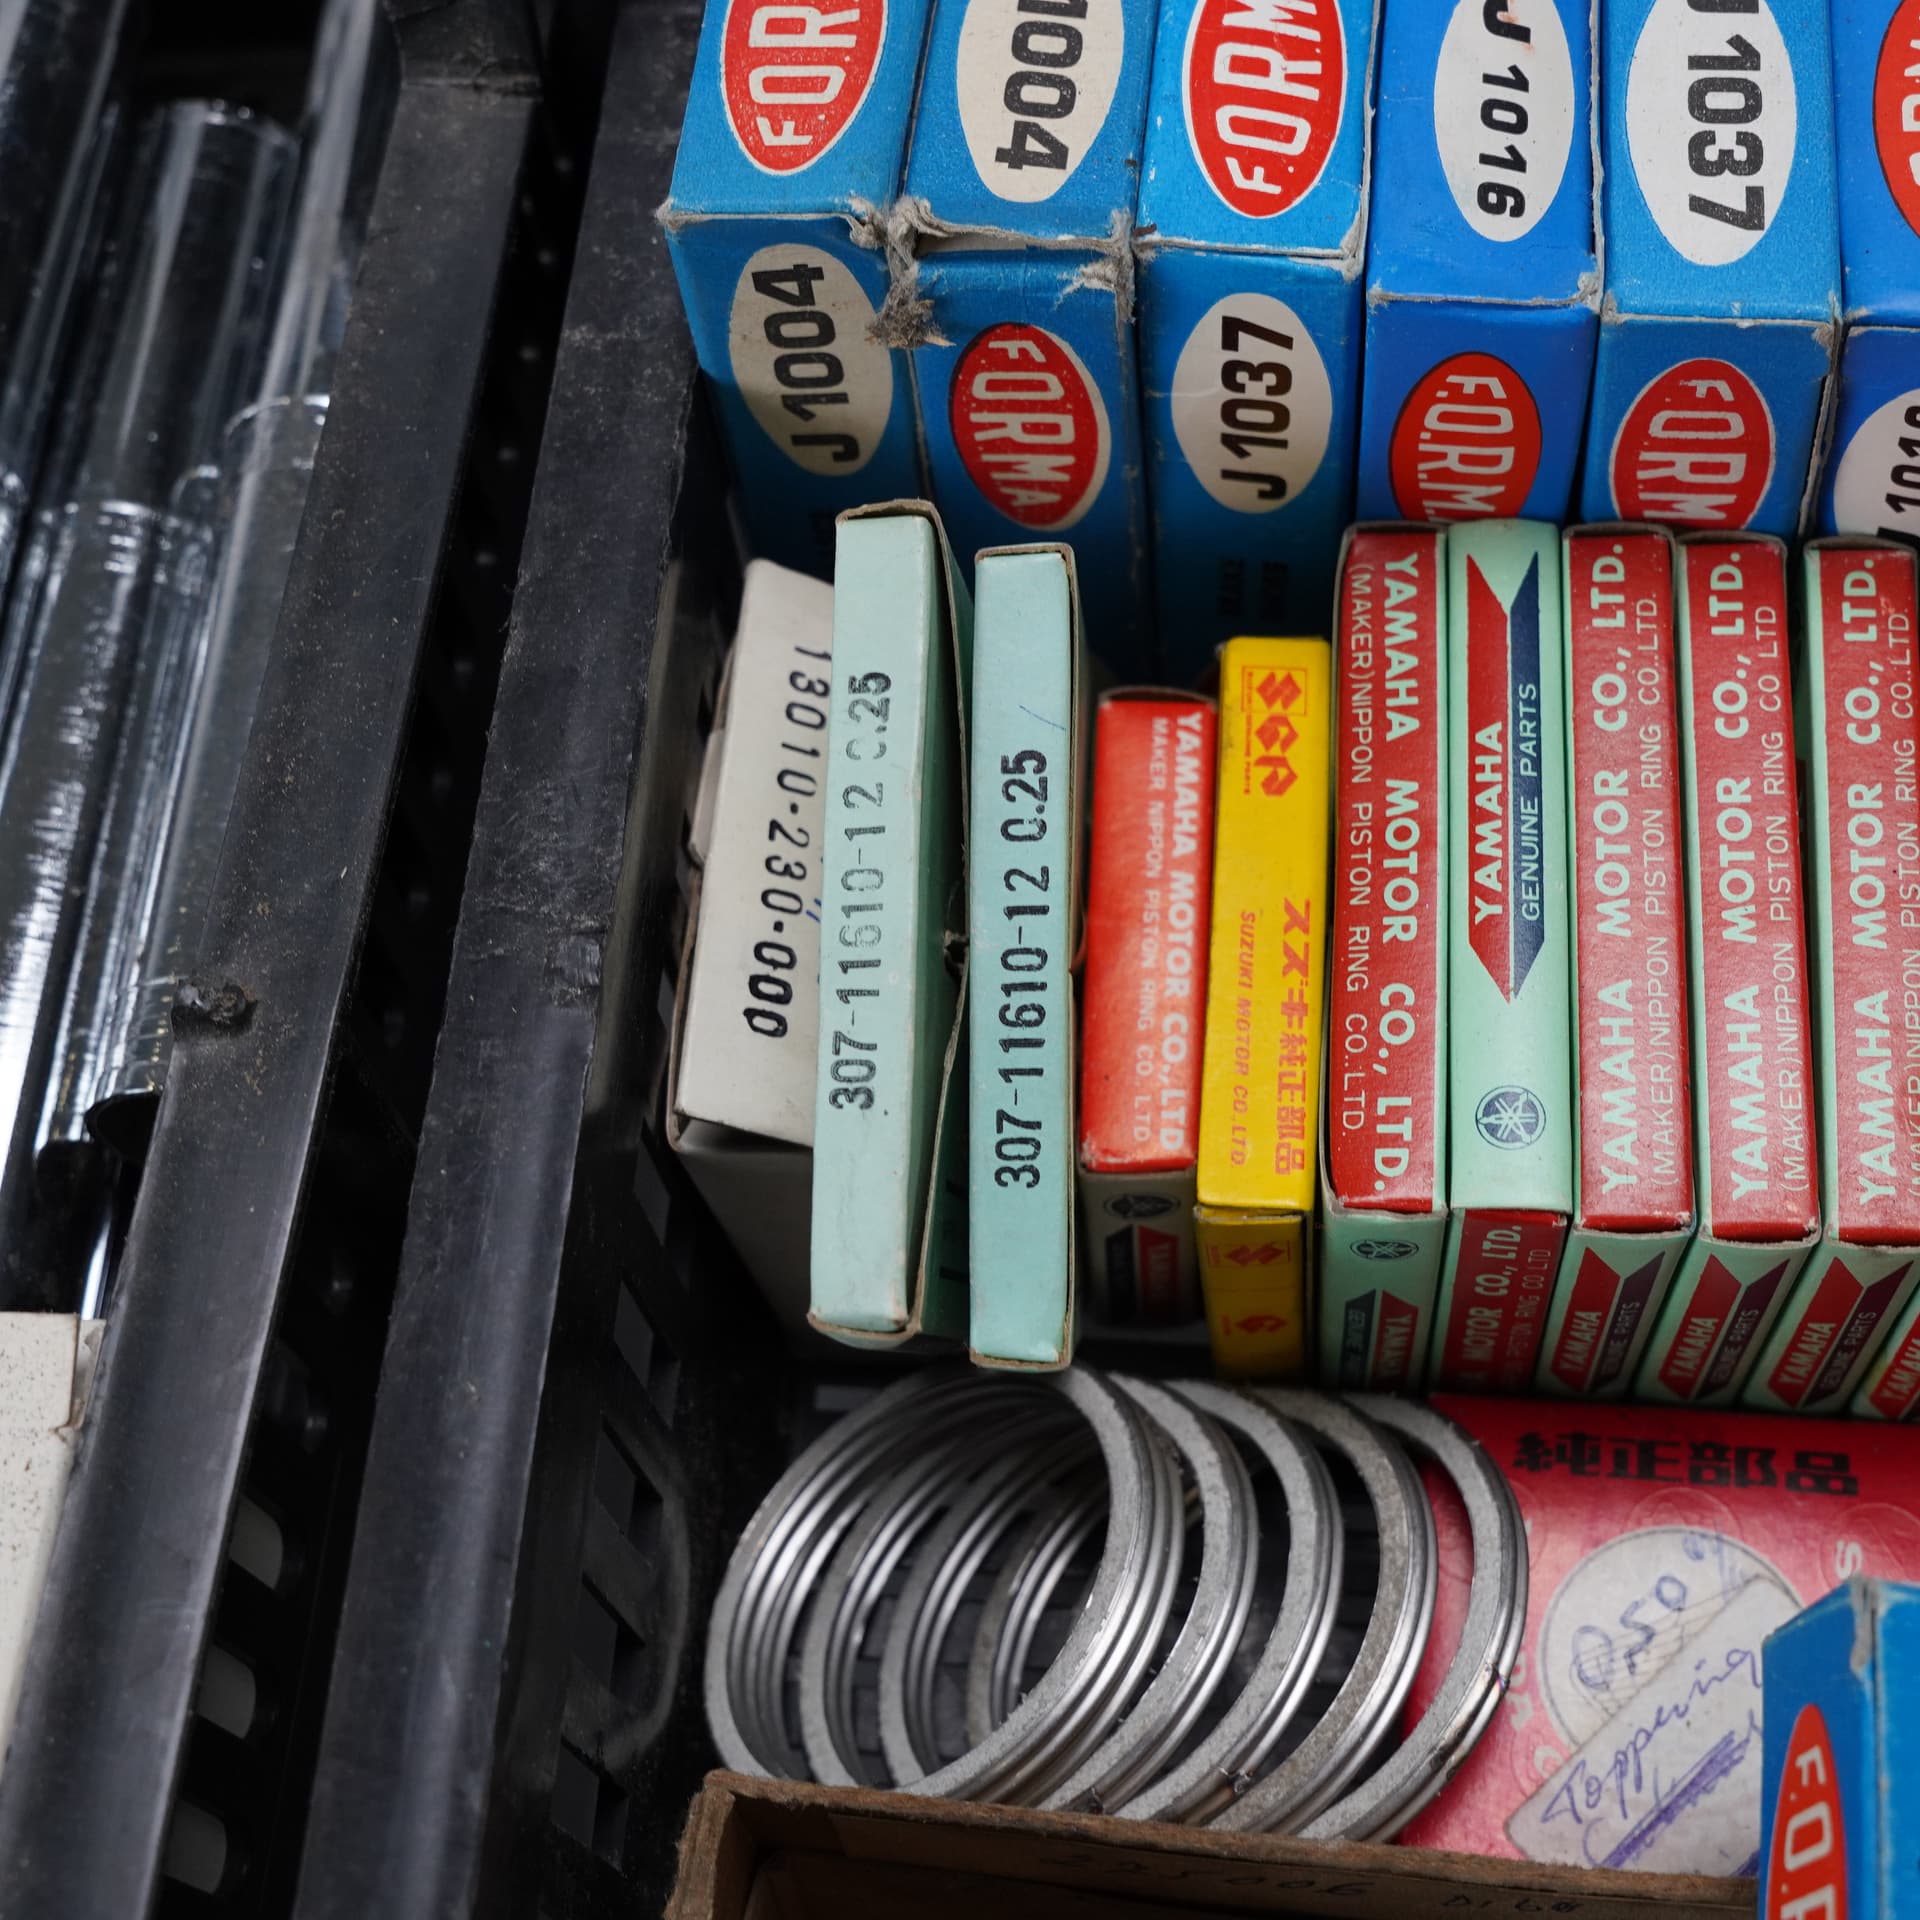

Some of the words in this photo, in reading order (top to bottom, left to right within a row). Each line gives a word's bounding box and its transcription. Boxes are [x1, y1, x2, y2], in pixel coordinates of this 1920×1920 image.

[1476, 64, 1531, 218] 1016
[1687, 34, 1765, 231] 1037
[751, 263, 851, 419] 1004
[1220, 315, 1294, 460] 1037
[790, 432, 861, 463] J
[1220, 468, 1288, 500] J
[1384, 552, 1419, 741] YAMAHA
[1151, 717, 1169, 791] MAKER
[1518, 683, 1537, 776] PARTS
[1639, 725, 1662, 788] RING
[1762, 733, 1785, 795] RING
[1894, 739, 1917, 801] RING
[1000, 750, 1049, 842] 0.25
[1172, 712, 1203, 857] YAMAHA
[1474, 722, 1502, 924] YAMAHA
[1145, 800, 1165, 878] NIPPON
[1349, 803, 1373, 905] PISTON
[1382, 779, 1420, 943] MOTOR
[1519, 797, 1539, 920] GENUINE
[1593, 770, 1632, 937] MOTOR
[1642, 810, 1666, 915] PISTON
[1715, 778, 1757, 943] MOTOR
[1766, 816, 1791, 921] PISTON
[1847, 784, 1888, 949] MOTOR
[1896, 823, 1920, 927] PISTON
[1141, 888, 1160, 968] PISTON
[1164, 869, 1196, 998] MOTOR
[1238, 911, 1256, 989] SUZUKI
[1347, 926, 1370, 992] RING
[994, 866, 1050, 1187] 307-11610-12
[1137, 978, 1156, 1031] RING
[1234, 996, 1252, 1075] MOTOR
[1597, 979, 1637, 1194] YAMAHA
[1724, 985, 1769, 1200] YAMAHA
[1853, 991, 1896, 1205] YAMAHA
[1461, 1306, 1504, 1362] MOTOR
[1559, 1310, 1603, 1372] YAMAHA
[1667, 1317, 1720, 1378] YAMAHA
[1777, 1322, 1837, 1385] YAMAHA
[1513, 1431, 1859, 1496] 純正部品
